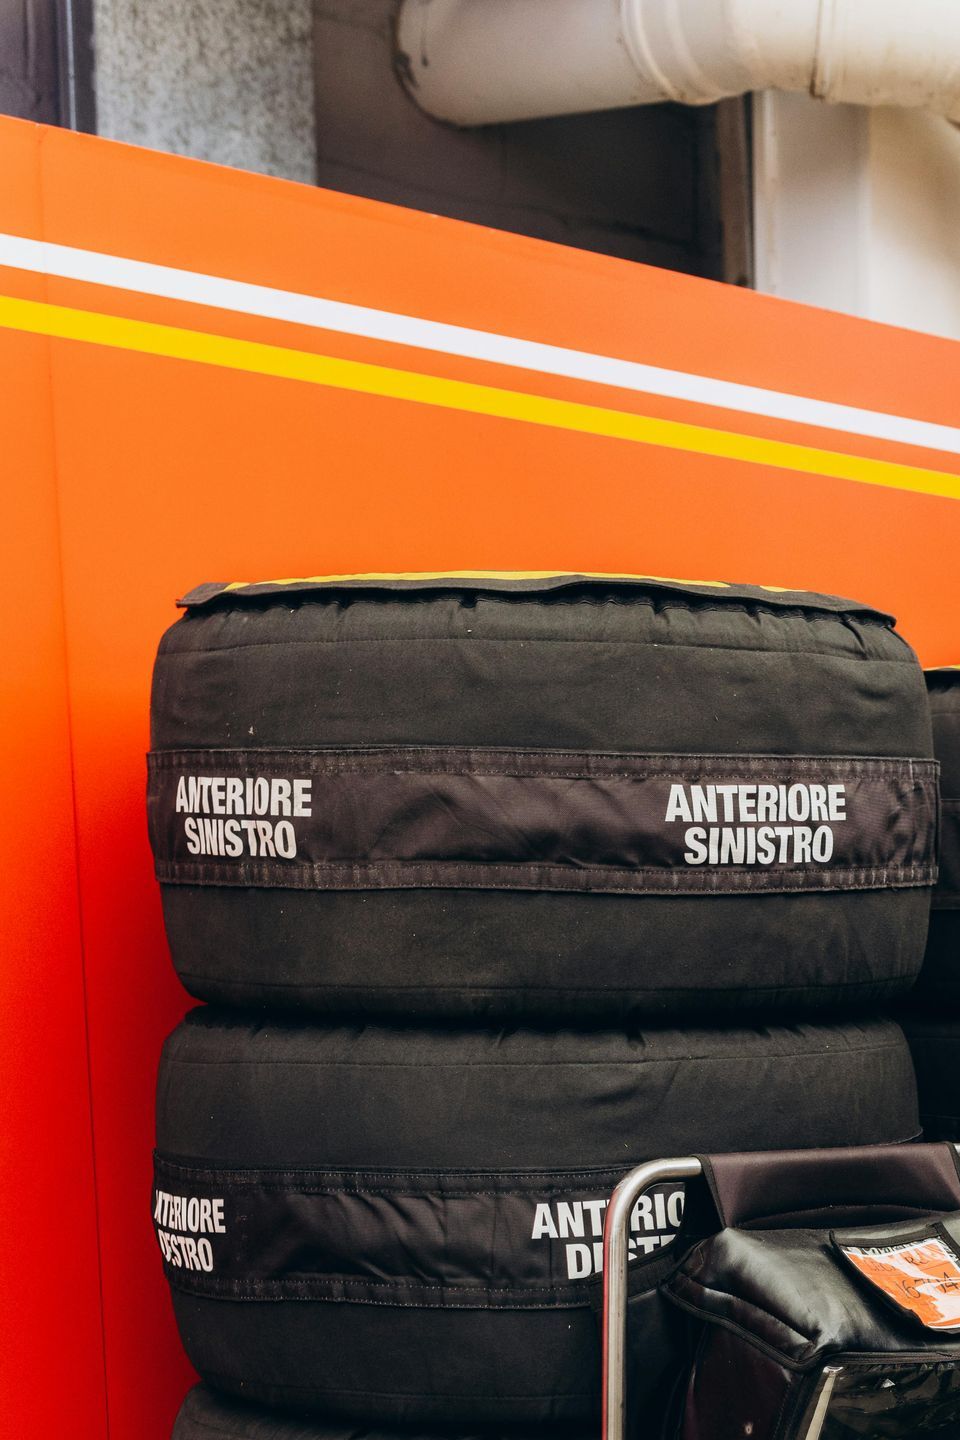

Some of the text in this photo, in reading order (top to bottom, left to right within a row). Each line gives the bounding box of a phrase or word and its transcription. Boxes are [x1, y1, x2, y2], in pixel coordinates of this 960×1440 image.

[175, 776, 312, 819] ANTERIORE
[665, 783, 848, 824] ANTERIORE
[185, 818, 297, 859] SINISTRO
[684, 825, 835, 865] SINISTRO
[154, 1189, 226, 1233] NTERIORE
[531, 1191, 685, 1239] ANTRIO
